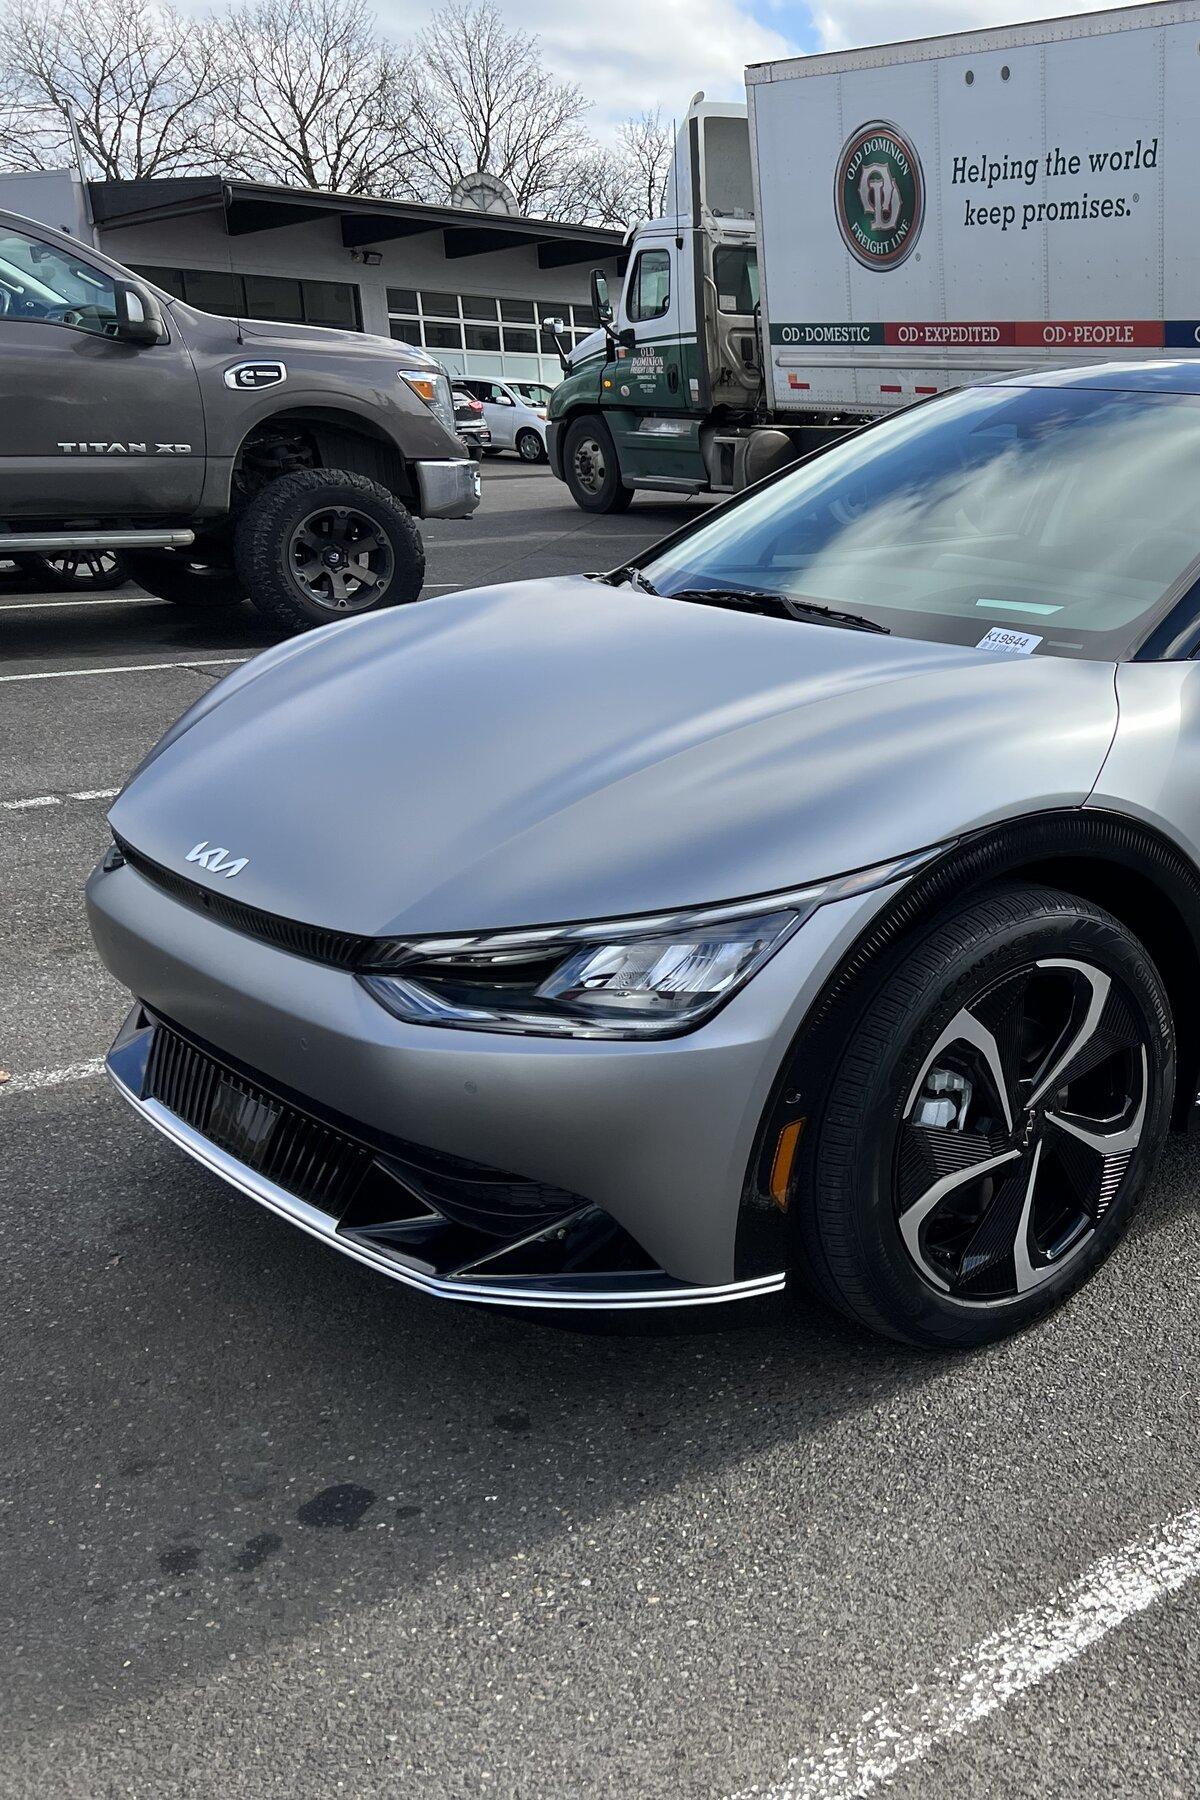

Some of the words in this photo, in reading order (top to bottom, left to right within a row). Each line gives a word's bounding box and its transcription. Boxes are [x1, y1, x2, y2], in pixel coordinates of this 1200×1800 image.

[847, 152, 863, 180] OLD
[863, 138, 911, 176] DOMINION
[952, 154, 1039, 189] Helping
[1046, 148, 1081, 177] the
[1088, 138, 1159, 172] world
[964, 200, 1016, 231] keep
[851, 222, 890, 255] FREIGHT
[891, 219, 910, 249] LINE
[640, 347, 654, 356] OLD
[57, 442, 147, 453] TITAN
[154, 443, 192, 453] XD
[984, 631, 1031, 648] K19844
[184, 841, 250, 879] KIA
